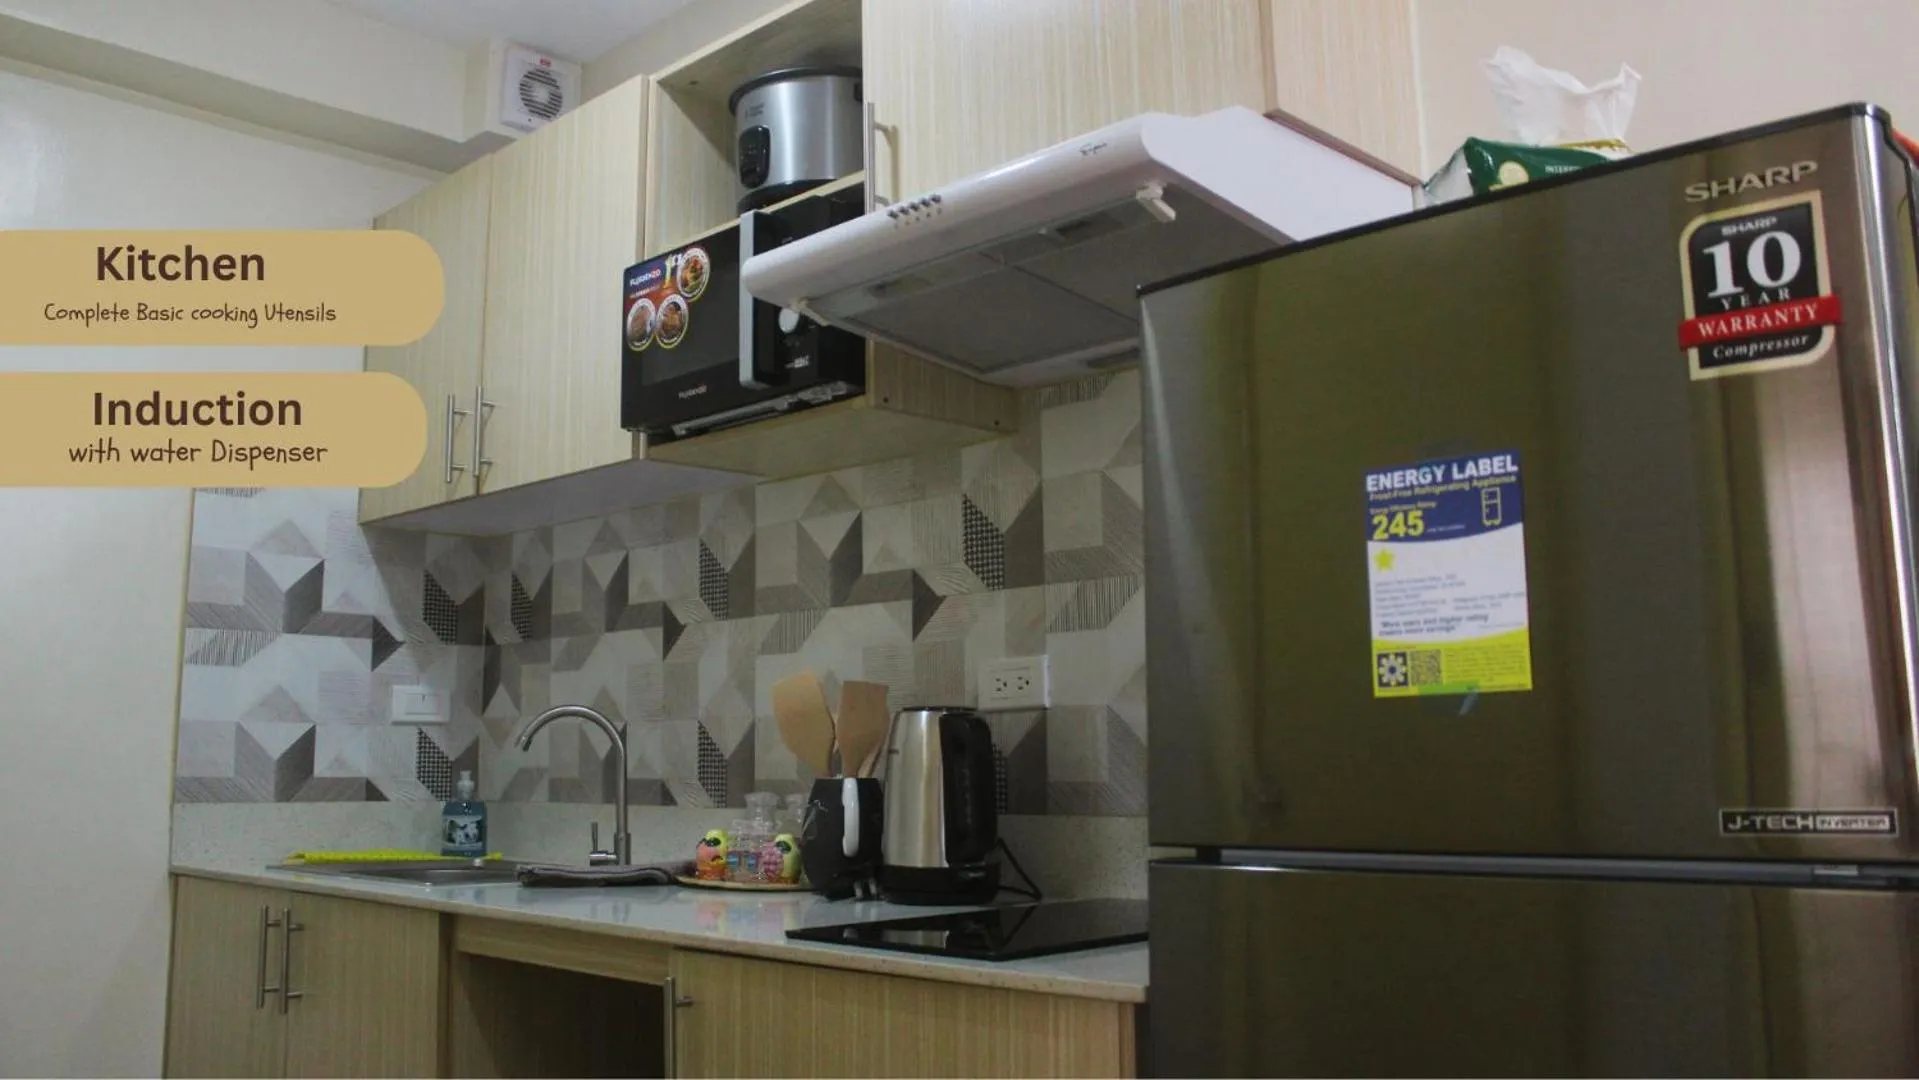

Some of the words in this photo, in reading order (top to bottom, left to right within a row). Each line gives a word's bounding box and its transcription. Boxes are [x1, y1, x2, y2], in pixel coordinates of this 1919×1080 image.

[1685, 160, 1818, 202] SHARP
[1721, 215, 1778, 236] SHARP
[1702, 231, 1801, 298] 10
[1721, 287, 1791, 311] YEAR
[1697, 303, 1818, 338] WARRANTY
[1713, 333, 1810, 359] Compressor
[1366, 464, 1445, 492] ENERGY
[1452, 454, 1519, 480] LABEL
[1472, 475, 1517, 488] Appliance
[1372, 510, 1425, 540] 245
[1728, 814, 1813, 830] J-TECH
[1818, 816, 1888, 830] INVERTER
